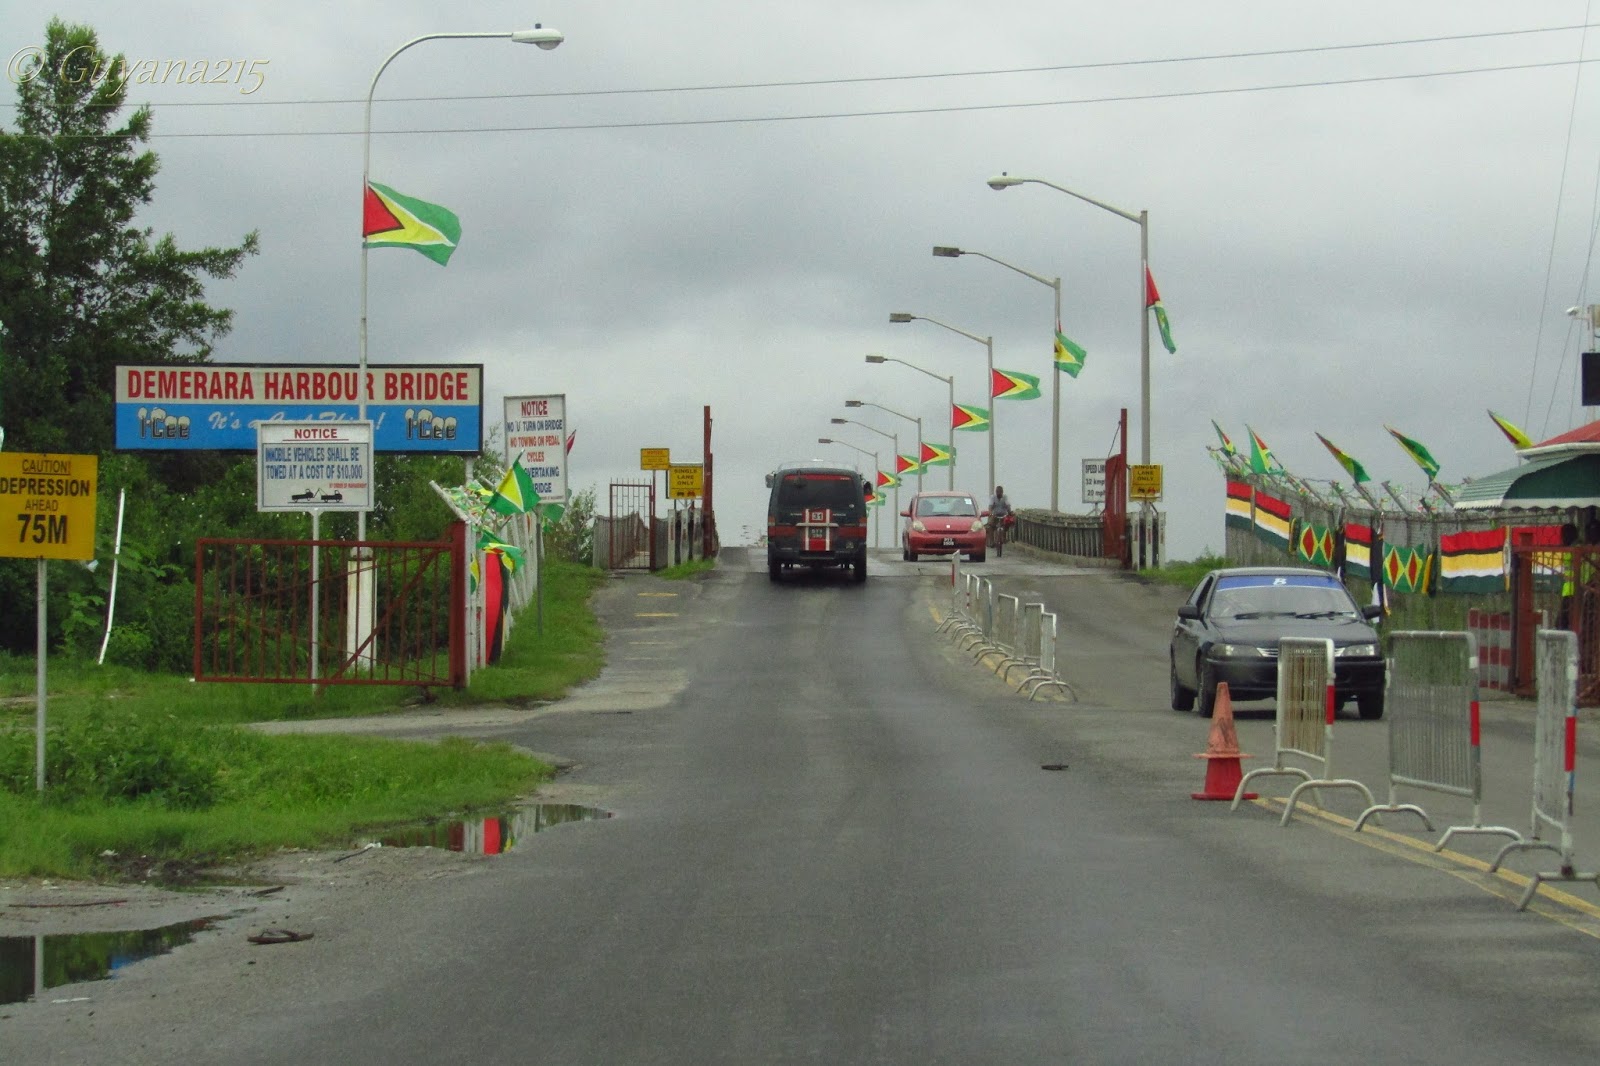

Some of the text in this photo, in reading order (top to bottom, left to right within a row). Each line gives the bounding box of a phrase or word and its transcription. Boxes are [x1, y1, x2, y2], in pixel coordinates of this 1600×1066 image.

[128, 370, 468, 400] DEMERARA HARBOUR BRIDGE
[522, 401, 547, 416] NOTICE
[523, 421, 535, 432] TURN
[536, 420, 544, 431] ON
[545, 420, 562, 430] BRIDGE
[294, 429, 337, 439] NOTICE
[518, 436, 536, 447] TOWING
[546, 436, 560, 447] PEDAL
[294, 448, 324, 461] VEHICLES
[328, 447, 349, 461] SHALL
[351, 447, 359, 461] BE
[527, 452, 544, 462] CYCLES
[22, 459, 71, 473] CAUTION!
[266, 466, 286, 479] TOWED
[289, 466, 297, 479] AT
[299, 466, 304, 479] A
[306, 465, 324, 479] COST
[326, 465, 335, 479] OF
[1086, 465, 1097, 473] SPEED
[0, 476, 90, 497] DEPRESSION
[535, 482, 552, 493] RIDGE
[25, 500, 59, 511] AHEAD
[18, 514, 68, 544] 75M
